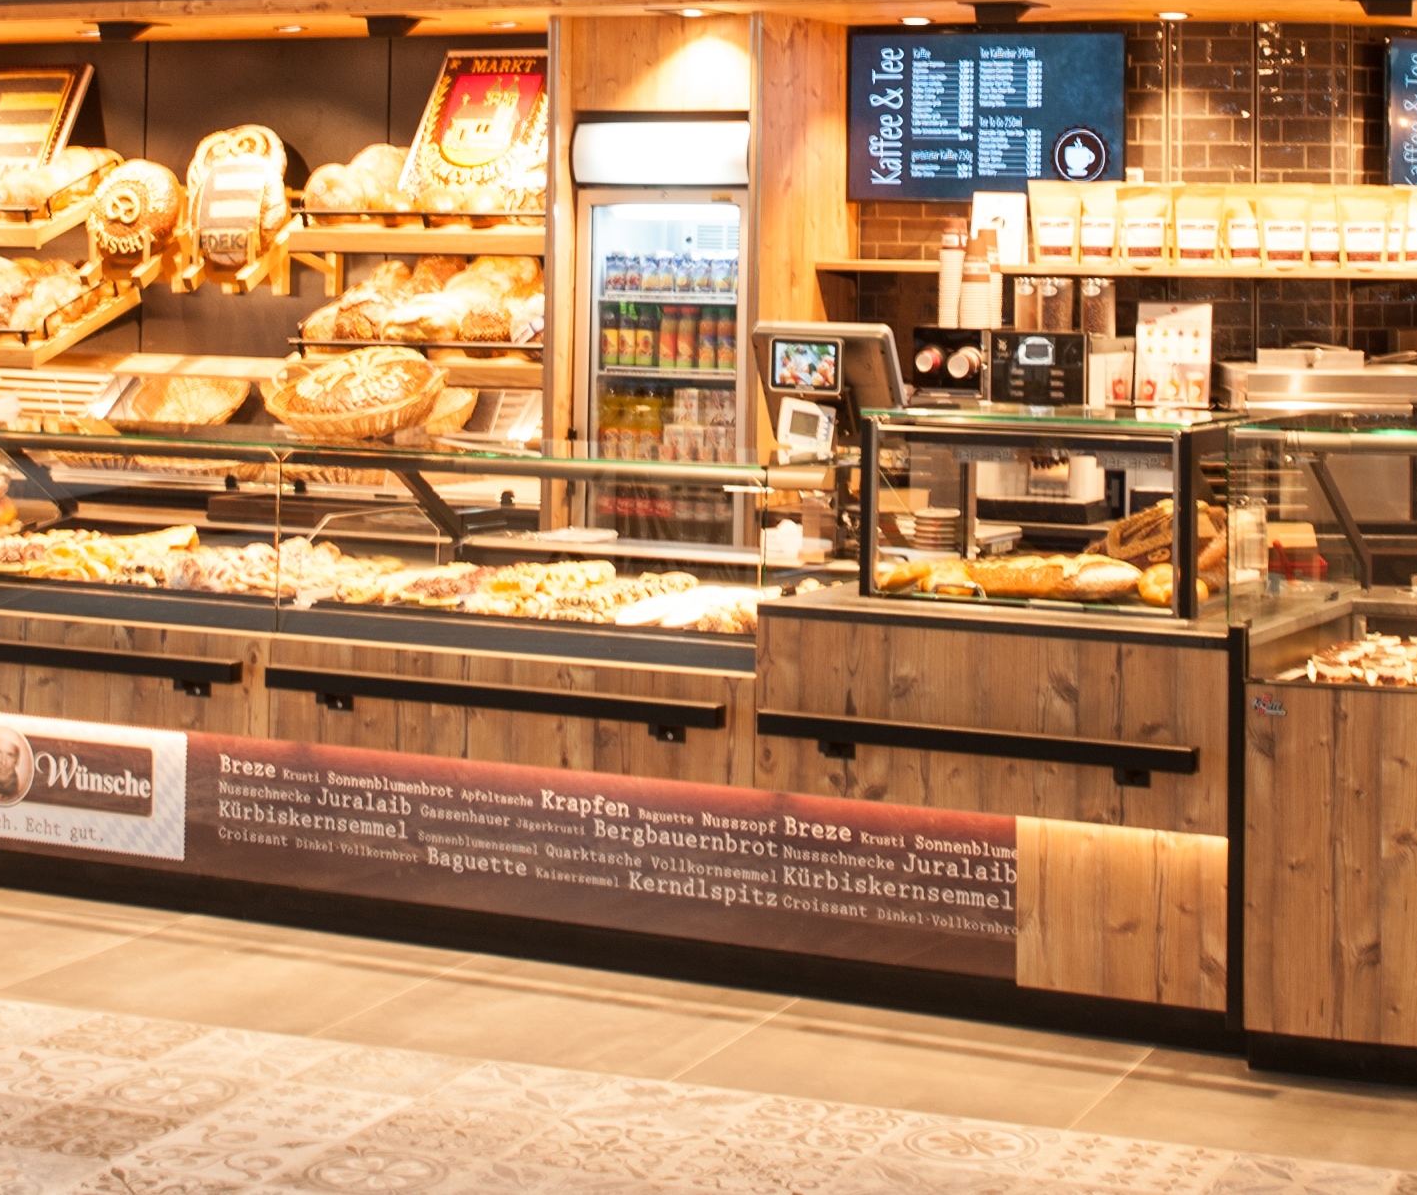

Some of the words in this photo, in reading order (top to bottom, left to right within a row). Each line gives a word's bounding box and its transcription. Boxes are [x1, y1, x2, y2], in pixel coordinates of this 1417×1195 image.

[472, 59, 536, 73] MARKT
[872, 47, 904, 85] Tee
[869, 87, 903, 110] &
[869, 114, 903, 185] Kaffee
[350, 366, 412, 402] BROT
[35, 750, 152, 798] Wünsche
[219, 753, 276, 779] Breze
[282, 767, 321, 783] Krusti
[326, 770, 454, 798] Sonnenblumenbrot
[461, 788, 534, 807] Apfeltasche
[540, 788, 630, 819] Krapfen
[638, 807, 695, 825] Baguette
[701, 811, 777, 836] Nusszopf
[783, 815, 852, 843] Breze
[860, 830, 906, 848] Krusti
[915, 834, 1017, 859] Sonnenblume
[26, 817, 61, 837] Echt
[70, 826, 105, 844] gut.
[218, 779, 312, 804] Nussschnecke
[317, 787, 412, 815] Juralaib
[420, 803, 511, 827] Gassenhauer
[515, 816, 585, 836] Jägerkrusti
[593, 817, 778, 858] Bergbauernbrot
[782, 844, 895, 870] Nussschnecke
[902, 852, 1017, 884] Juralaib
[218, 799, 409, 839] Kürbiskernsemmel
[418, 829, 538, 855] Sonnenblumensemmel
[545, 843, 642, 867] Quarktasche
[650, 855, 778, 883] Vollkornsemmel
[783, 865, 1014, 911] Kürbiskernsemmel
[218, 825, 288, 847] Croissant
[295, 838, 419, 863] Dinkel-Vollkornbrot
[426, 845, 527, 877] Baguette
[535, 865, 620, 888] Kaisersemmel
[628, 870, 778, 907] Kerndlspitz
[783, 895, 868, 918] Croissant
